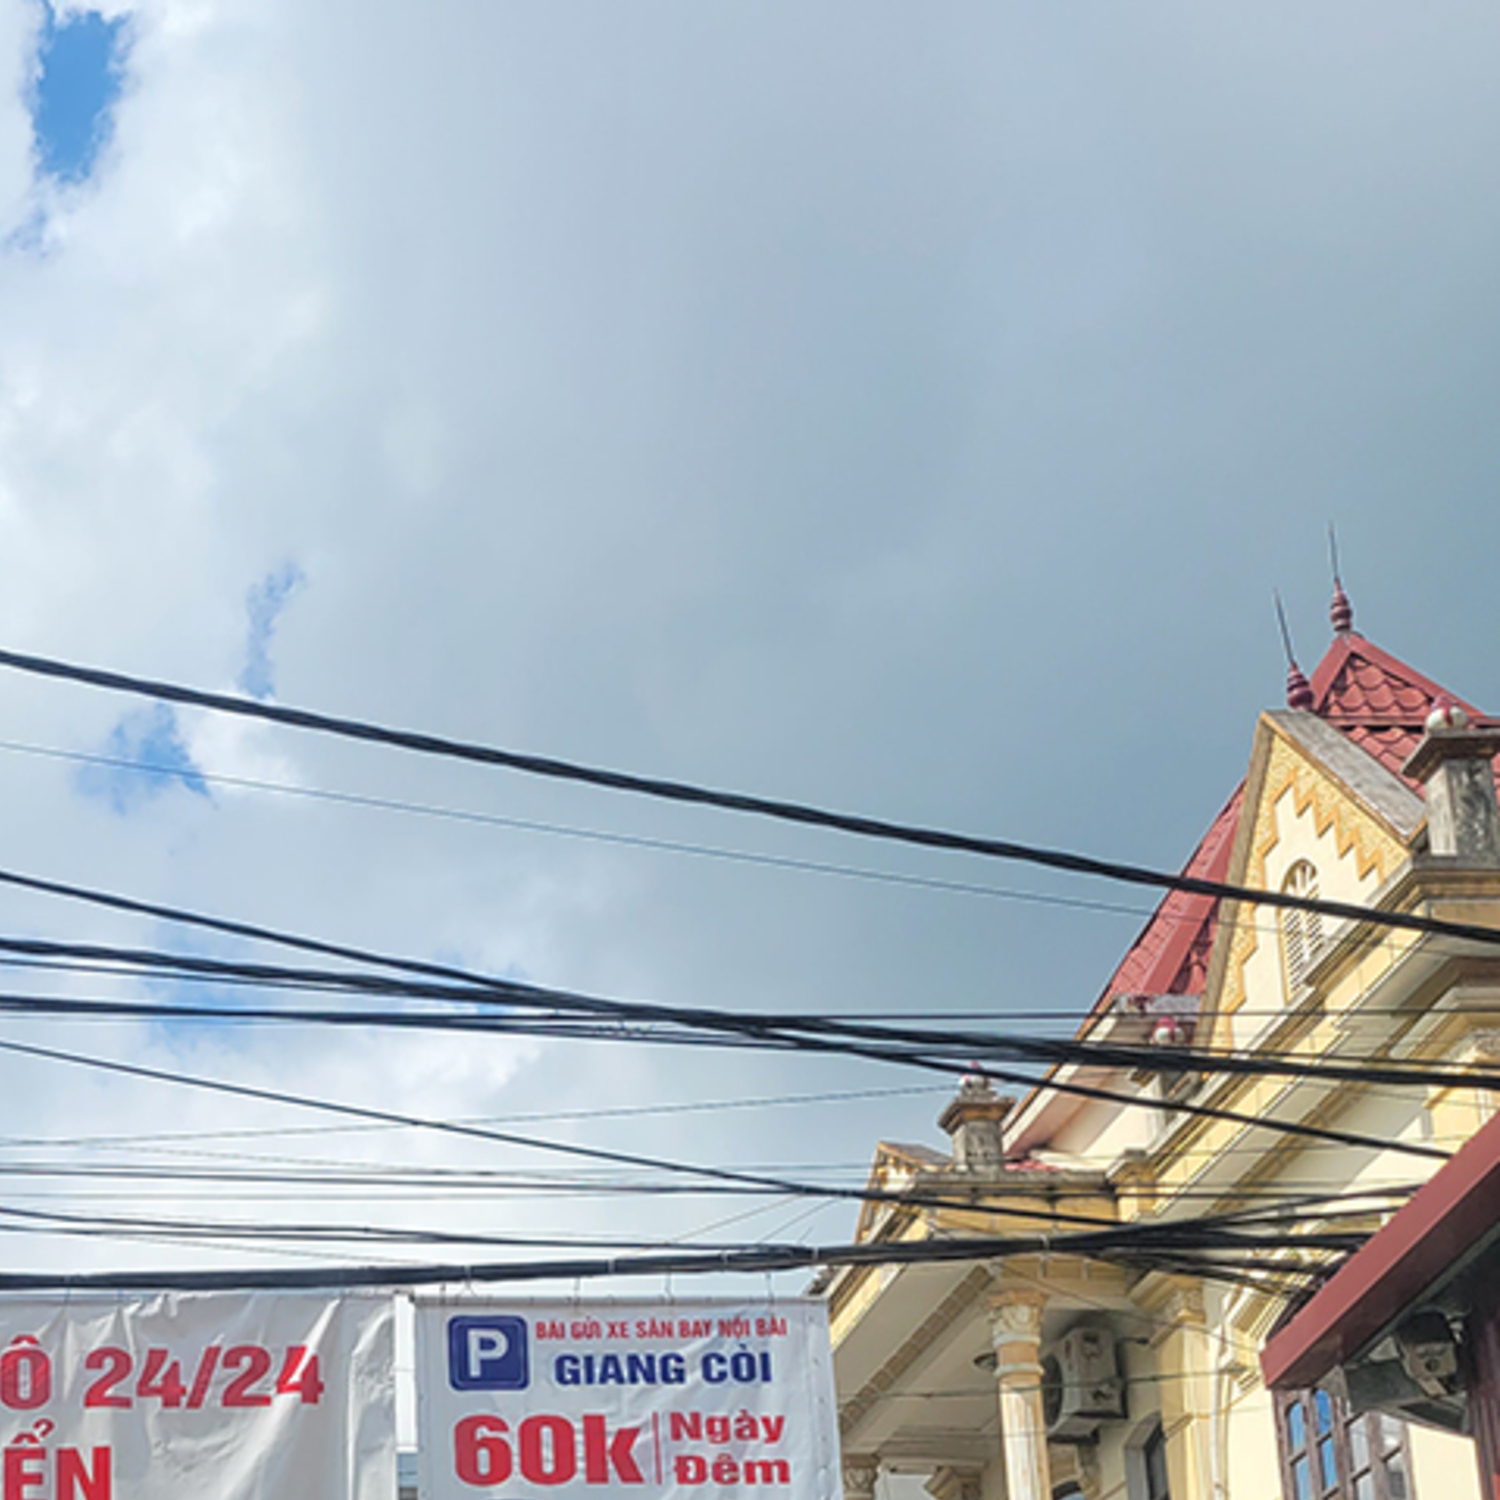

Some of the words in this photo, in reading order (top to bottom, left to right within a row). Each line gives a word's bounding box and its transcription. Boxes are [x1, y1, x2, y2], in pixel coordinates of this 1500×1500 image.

[607, 1320, 630, 1340] XE
[677, 1319, 712, 1339] BAY
[84, 1345, 325, 1410] 24/24
[554, 1352, 686, 1386] GIANG
[700, 1343, 771, 1384] CÒI
[454, 1413, 645, 1487] 60k
[669, 1409, 785, 1446] Ngày
[674, 1454, 791, 1486] Đêm
